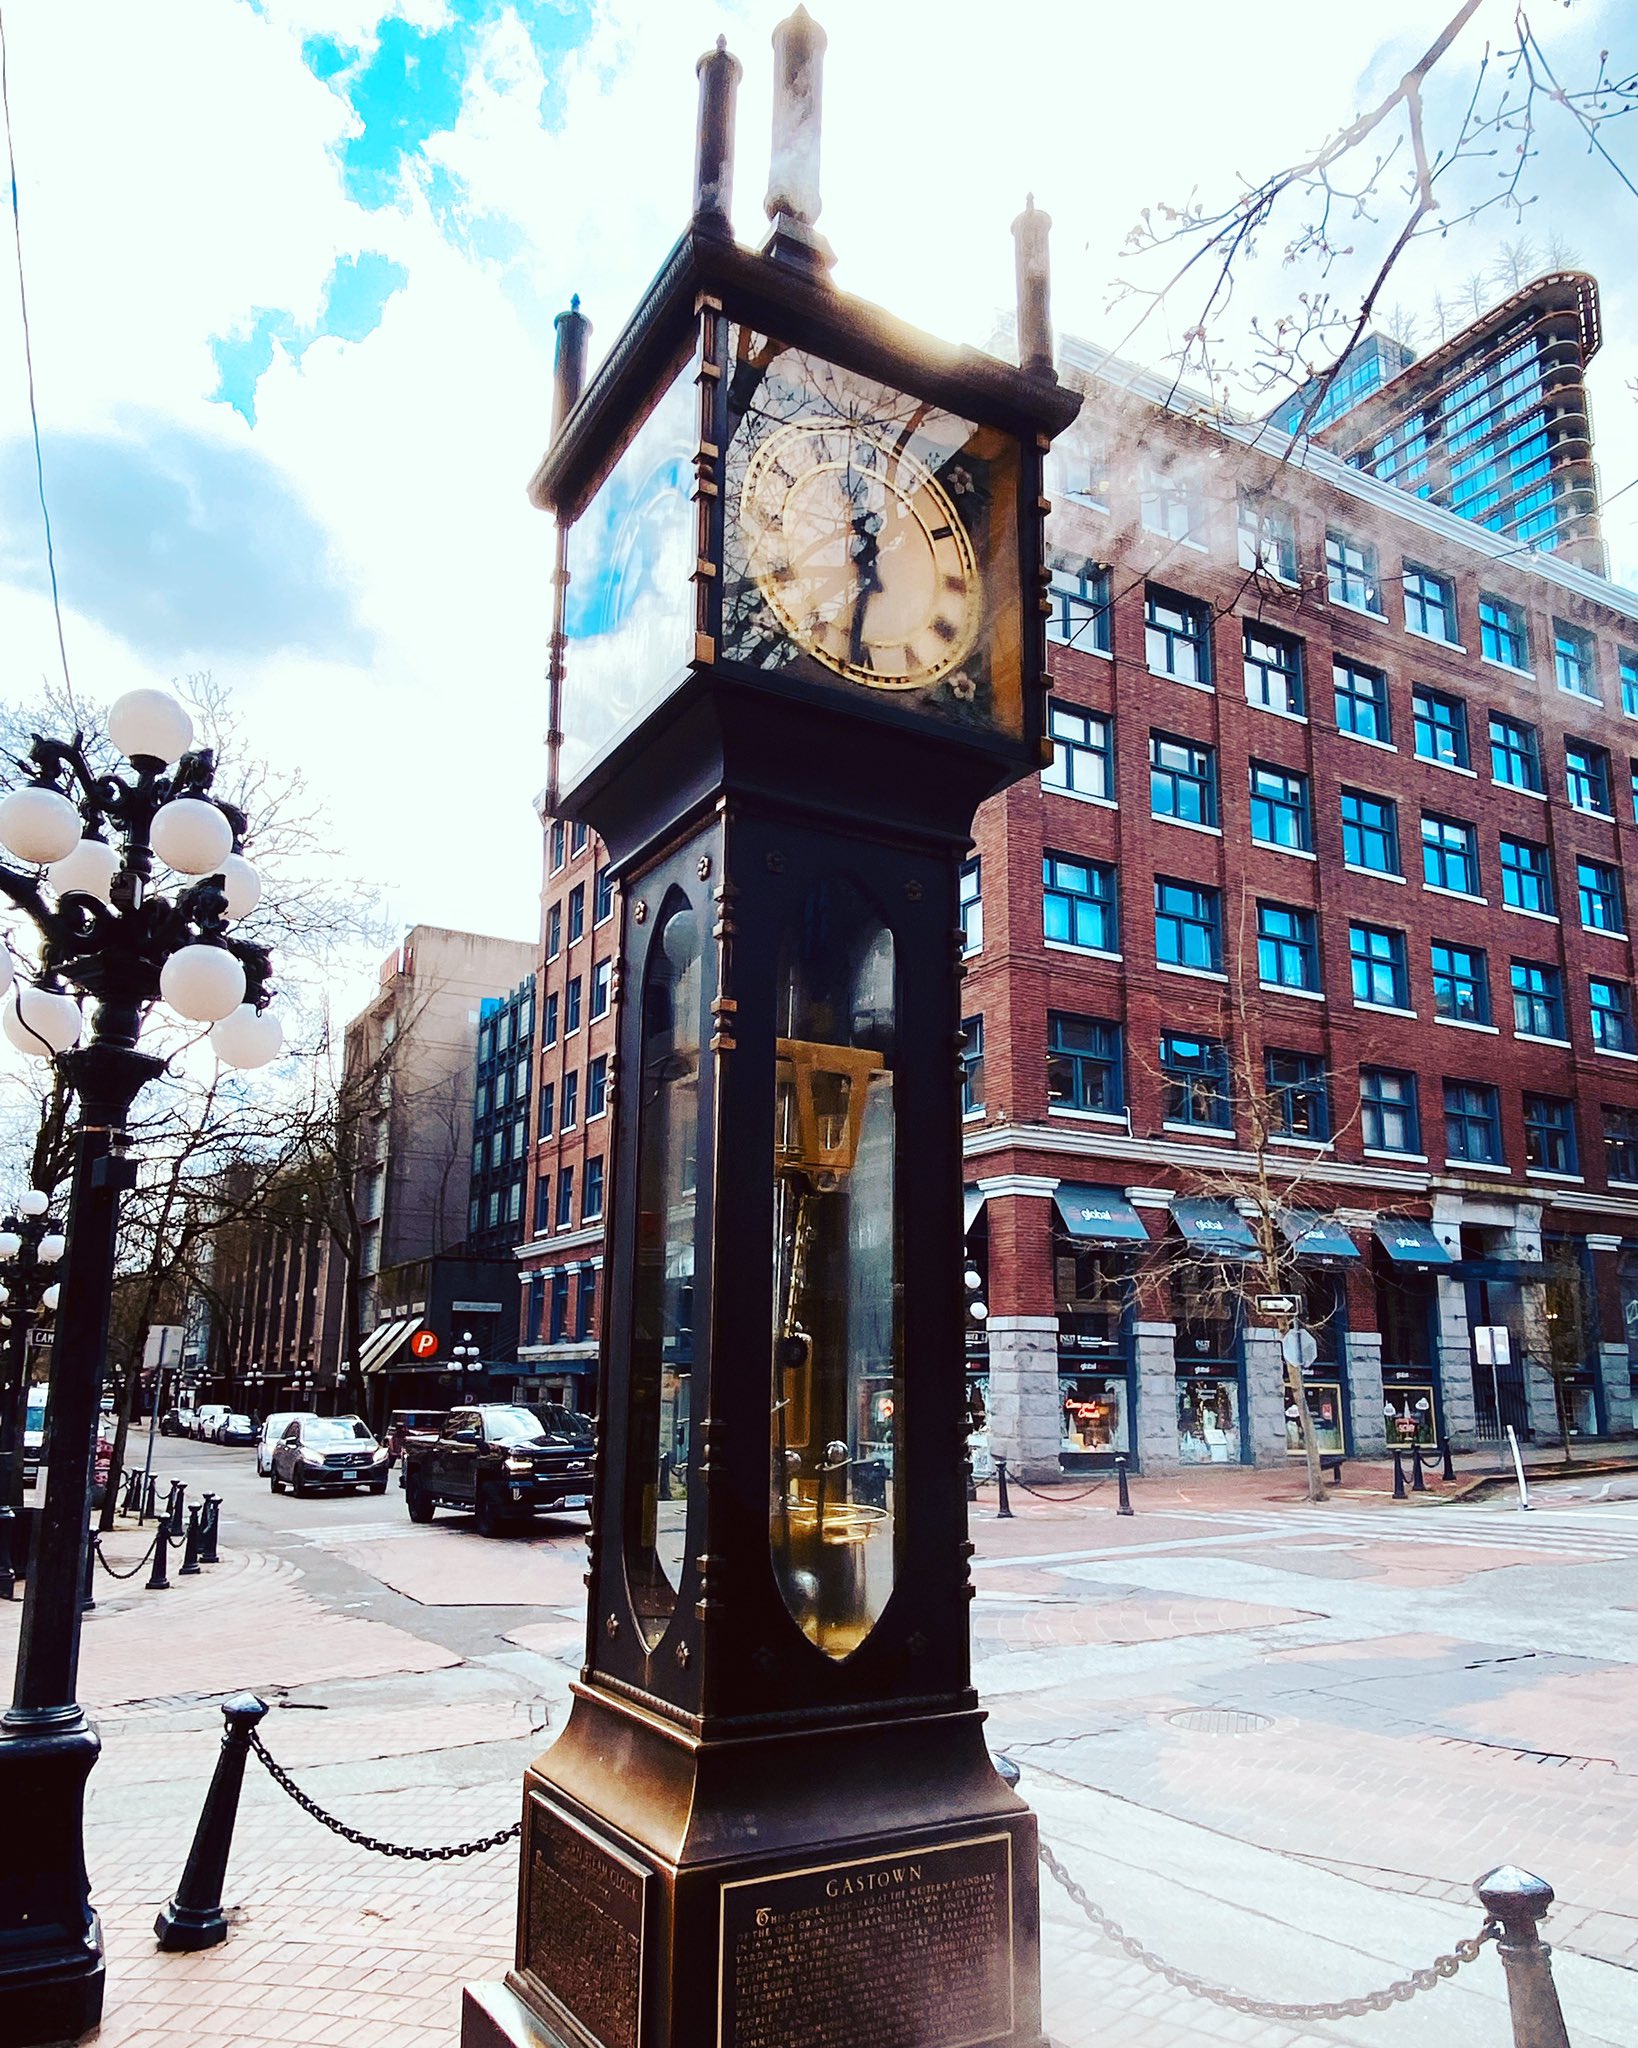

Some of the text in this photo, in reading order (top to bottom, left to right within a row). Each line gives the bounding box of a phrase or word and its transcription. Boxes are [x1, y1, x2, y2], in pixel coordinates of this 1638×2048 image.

[1080, 1208, 1112, 1221] global
[418, 1335, 434, 1354] P
[826, 1865, 922, 1897] GASTOWN
[756, 1907, 785, 1926] THIS
[753, 1929, 769, 1938] THE
[777, 1934, 793, 1943] THE
[799, 1927, 829, 1939] SHORE
[772, 1942, 805, 1955] NORTH
